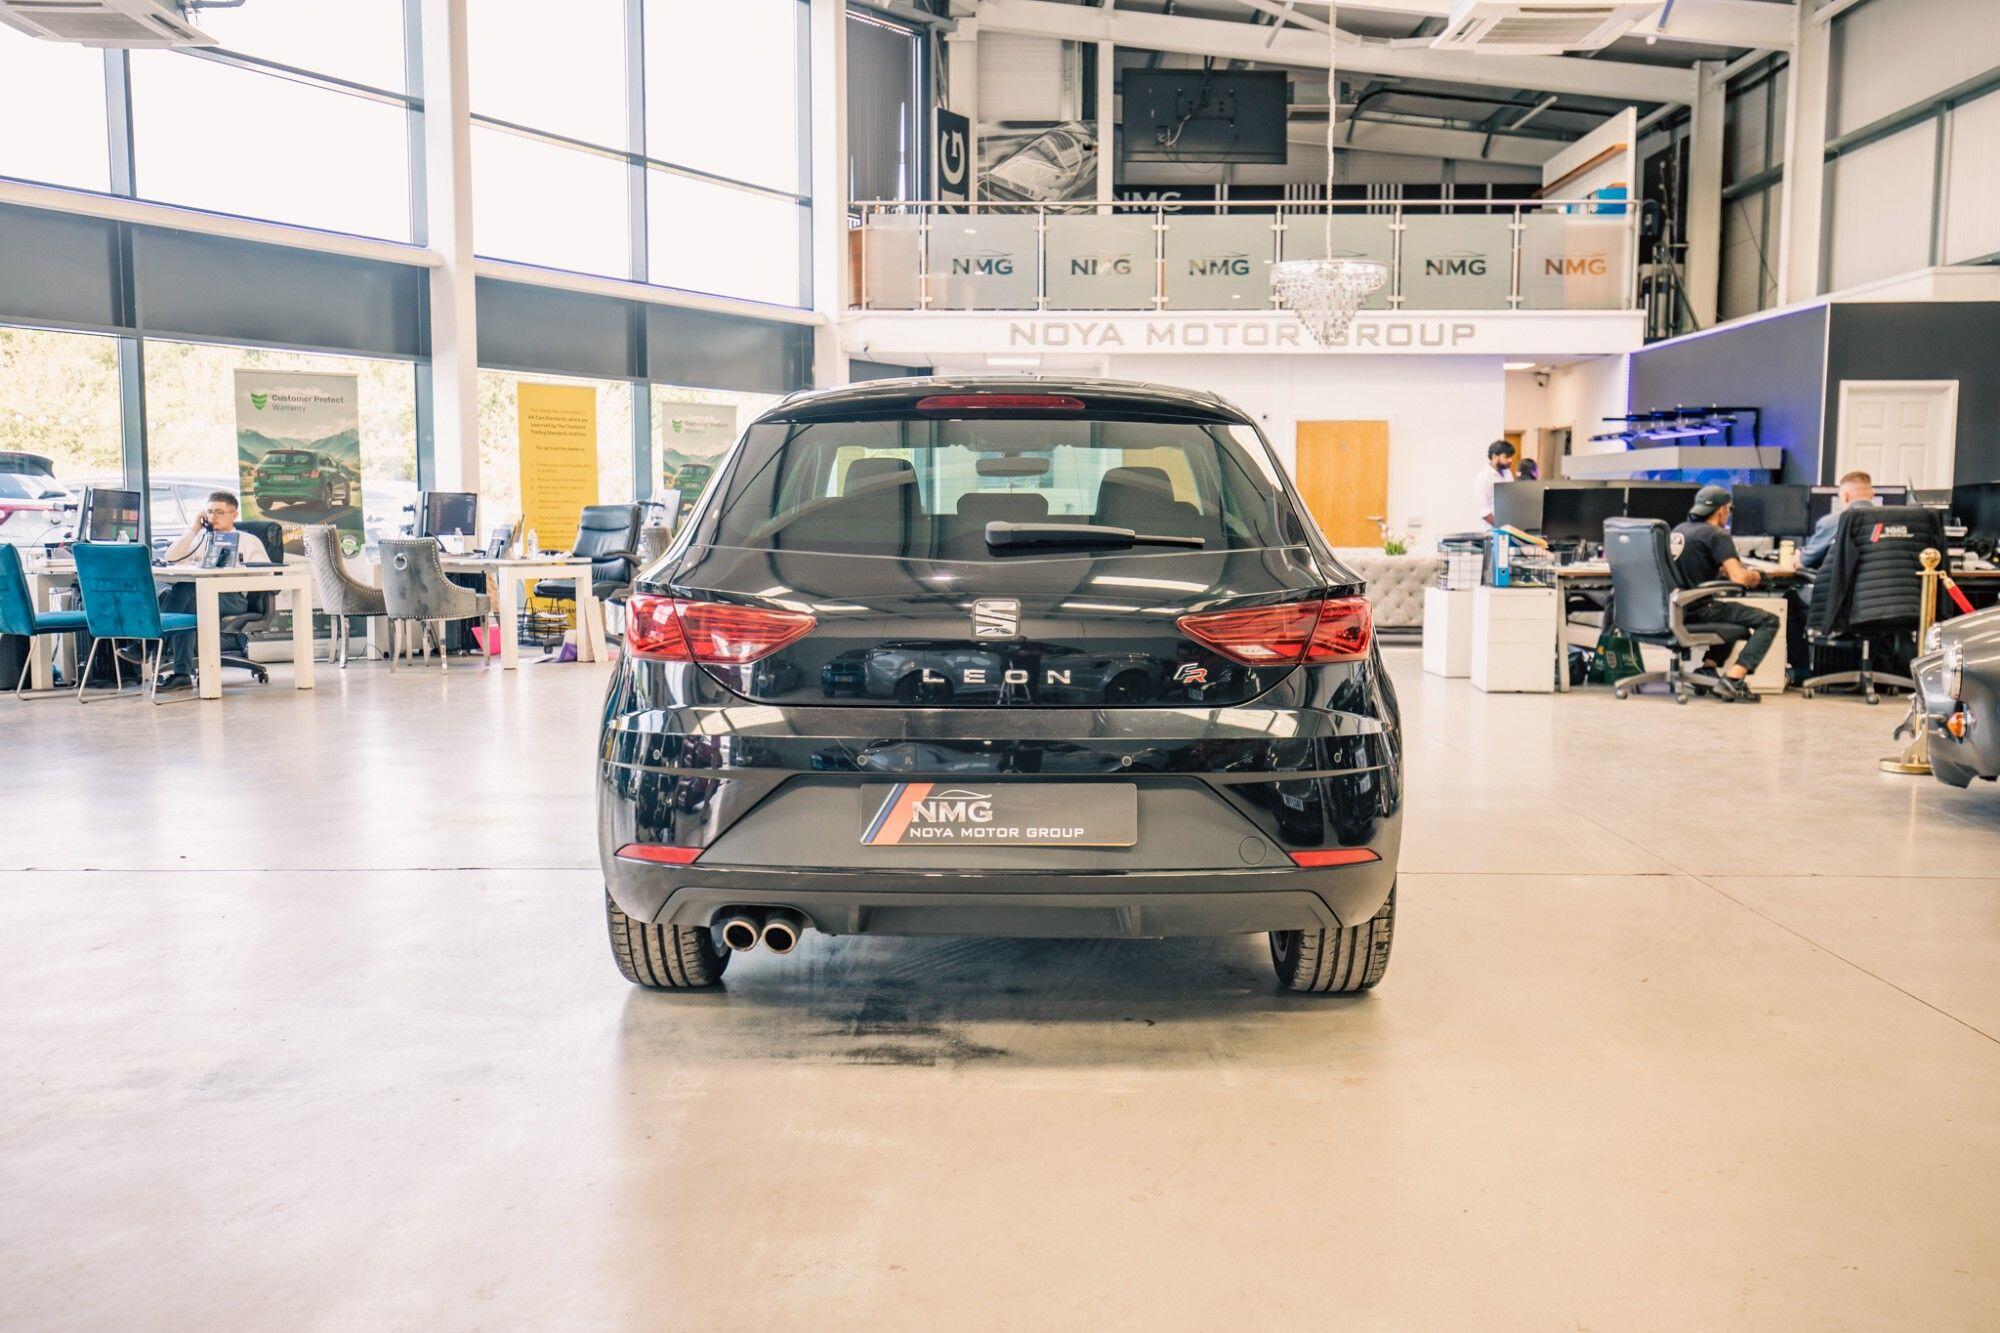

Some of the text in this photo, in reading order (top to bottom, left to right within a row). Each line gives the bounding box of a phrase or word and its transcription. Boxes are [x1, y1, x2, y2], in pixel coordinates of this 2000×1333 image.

[952, 259, 1014, 275] NMG
[1188, 259, 1251, 276] NMG
[1425, 258, 1487, 276] NMG
[1545, 258, 1607, 276] NMG
[1010, 322, 1125, 346] NOYA
[1146, 322, 1302, 346] MOTOR
[271, 394, 344, 403] Customer Protect
[271, 404, 307, 412] Warranty
[922, 668, 1072, 684] LEON
[1172, 662, 1208, 684] FR
[911, 800, 993, 823] NMG
[909, 827, 1085, 838] NOYA MOTOR GROUP
